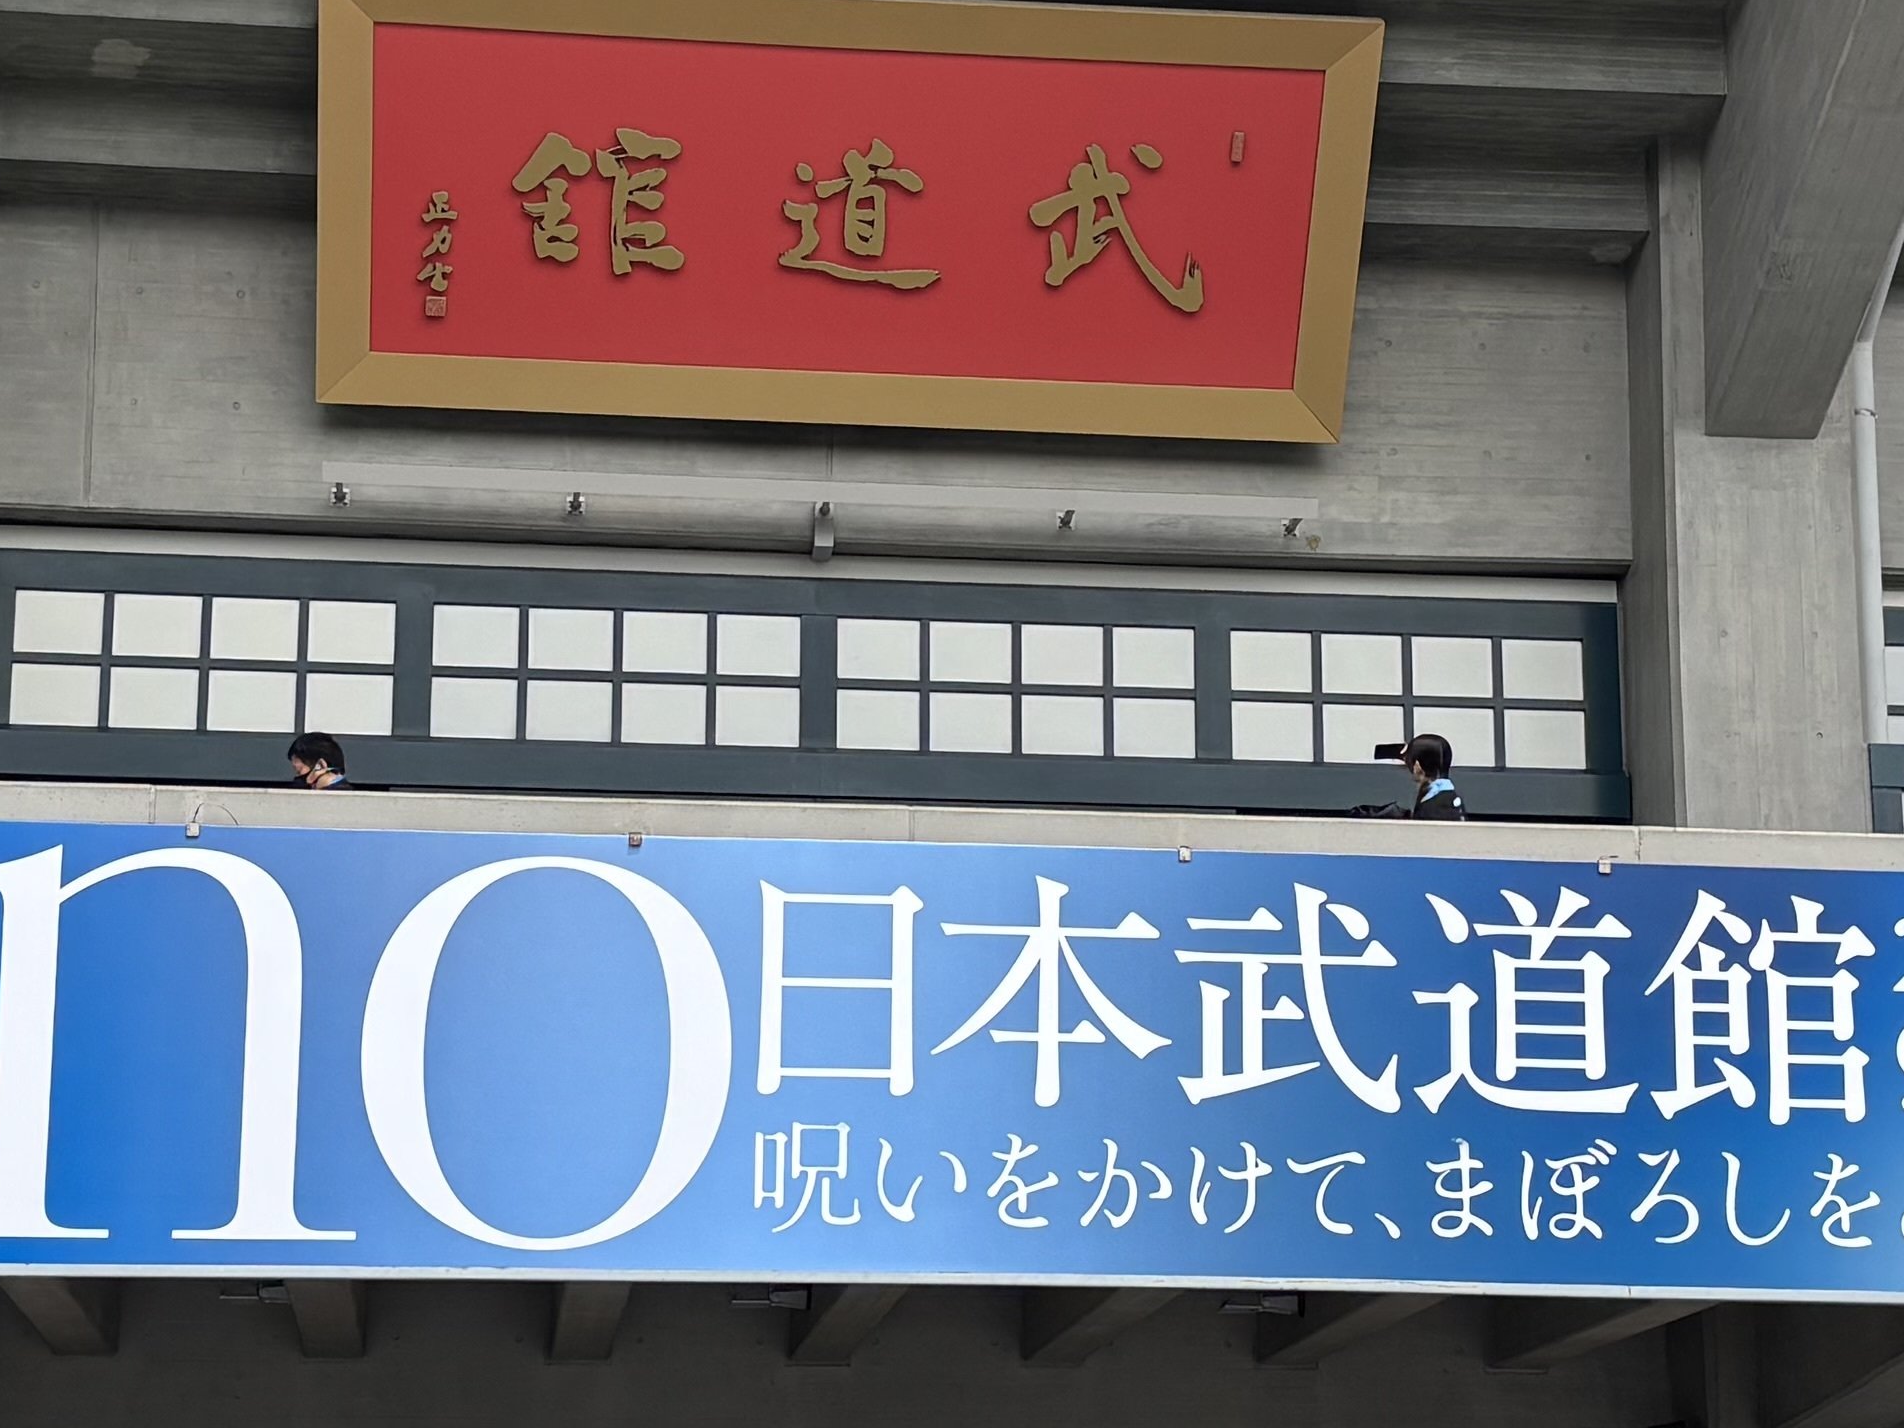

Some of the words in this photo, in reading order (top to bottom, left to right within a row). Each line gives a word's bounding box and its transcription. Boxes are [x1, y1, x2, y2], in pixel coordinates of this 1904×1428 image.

[755, 875, 1876, 1126] 日本武道館
